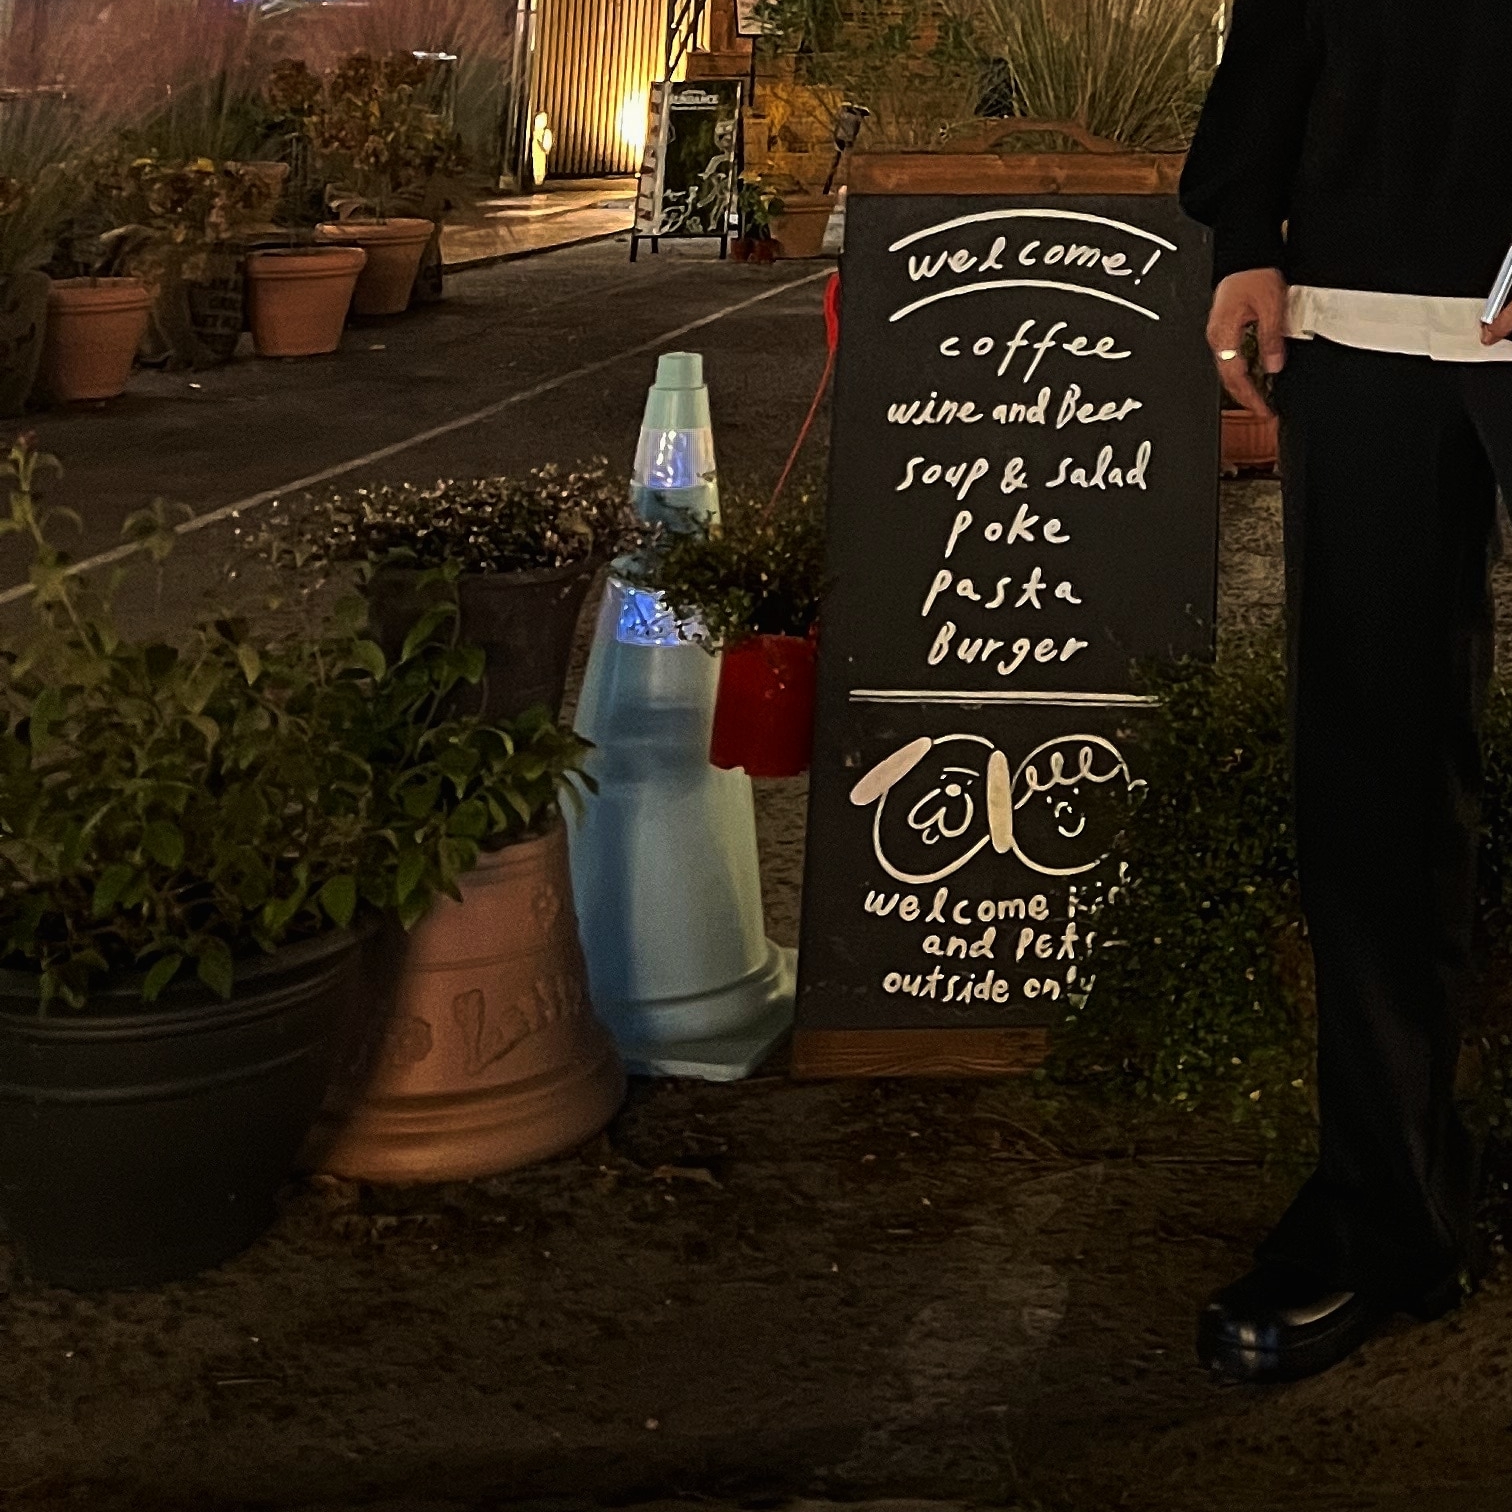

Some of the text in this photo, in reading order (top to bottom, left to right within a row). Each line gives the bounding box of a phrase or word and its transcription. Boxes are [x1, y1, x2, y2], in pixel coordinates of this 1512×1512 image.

[907, 236, 1163, 285] welcome!
[939, 319, 1132, 384] coffee
[886, 383, 1143, 429] wine and Beer
[895, 439, 1153, 501] soup & salad
[921, 566, 1082, 617] pasta
[927, 621, 1089, 676] Burger
[863, 886, 1050, 926] welcome
[921, 926, 997, 960] and
[882, 966, 1010, 1005] outside
